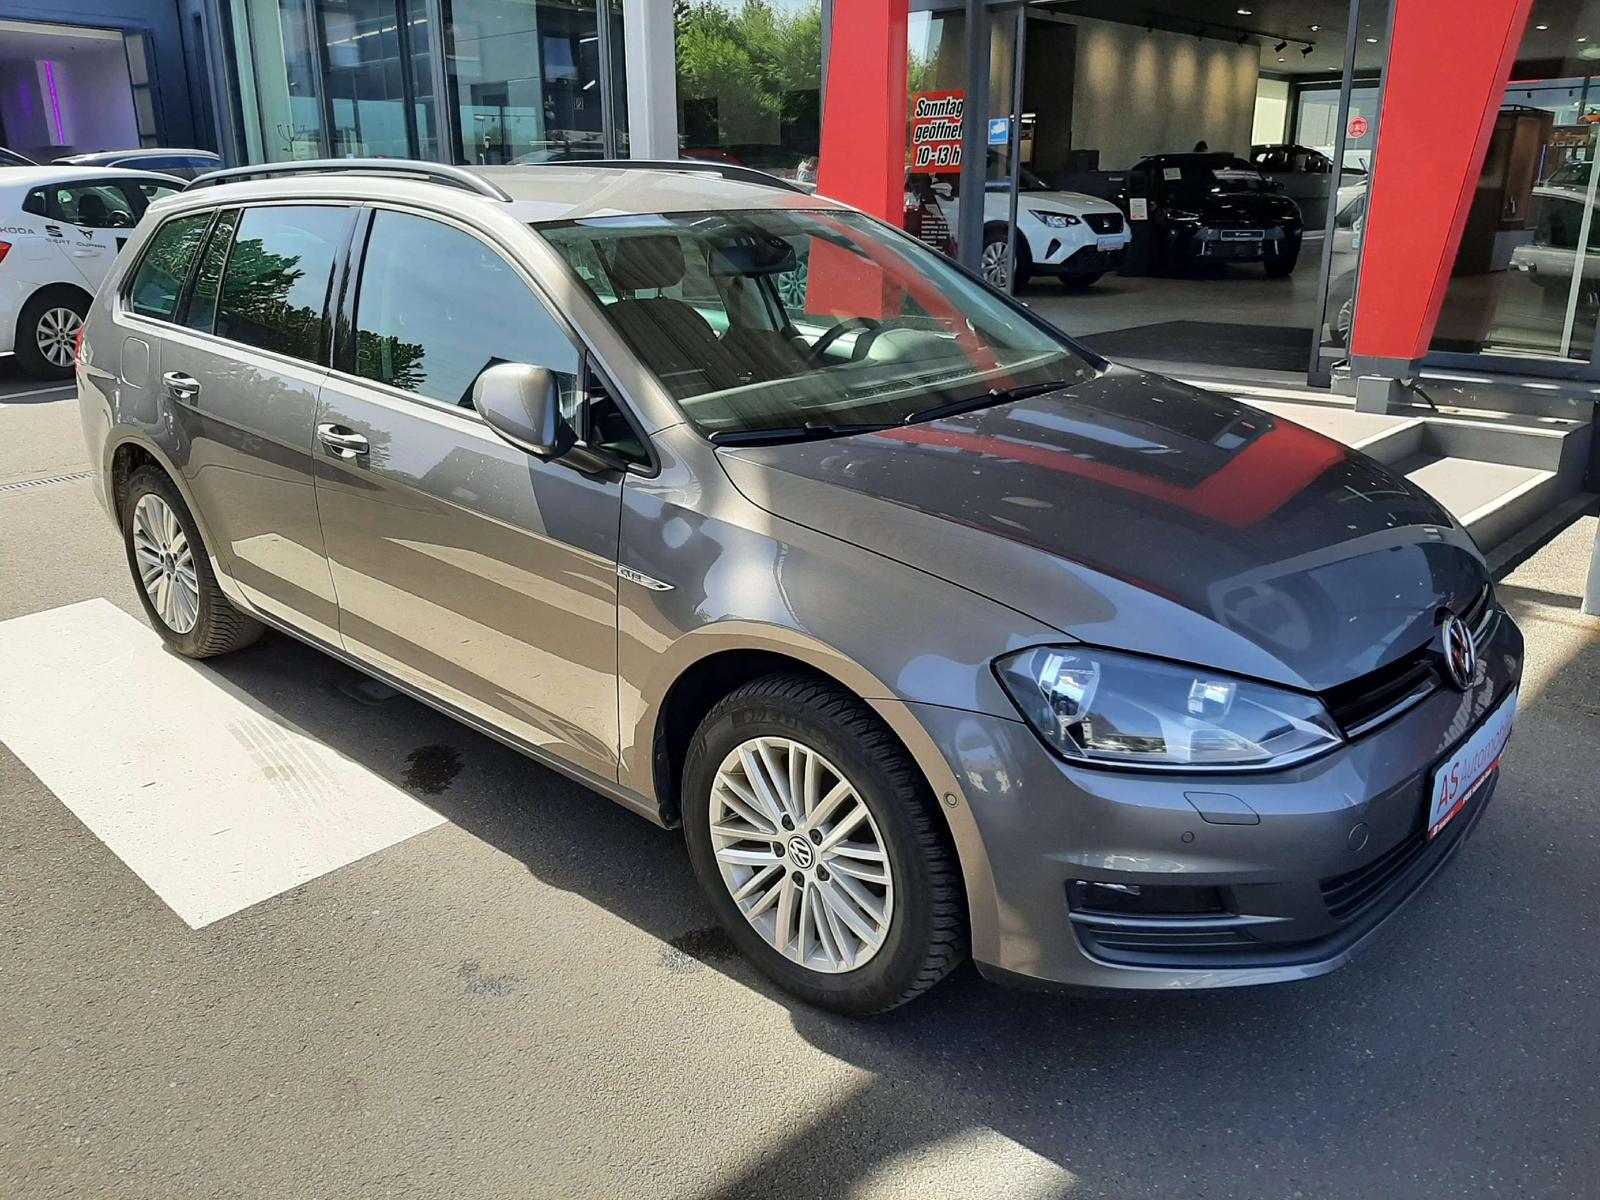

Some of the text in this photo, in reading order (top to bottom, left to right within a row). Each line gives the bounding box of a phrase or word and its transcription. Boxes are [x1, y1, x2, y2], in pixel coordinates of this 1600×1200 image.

[915, 96, 964, 119] Sonntag
[915, 146, 962, 166] 10-13 h
[1436, 762, 1460, 816] AS
